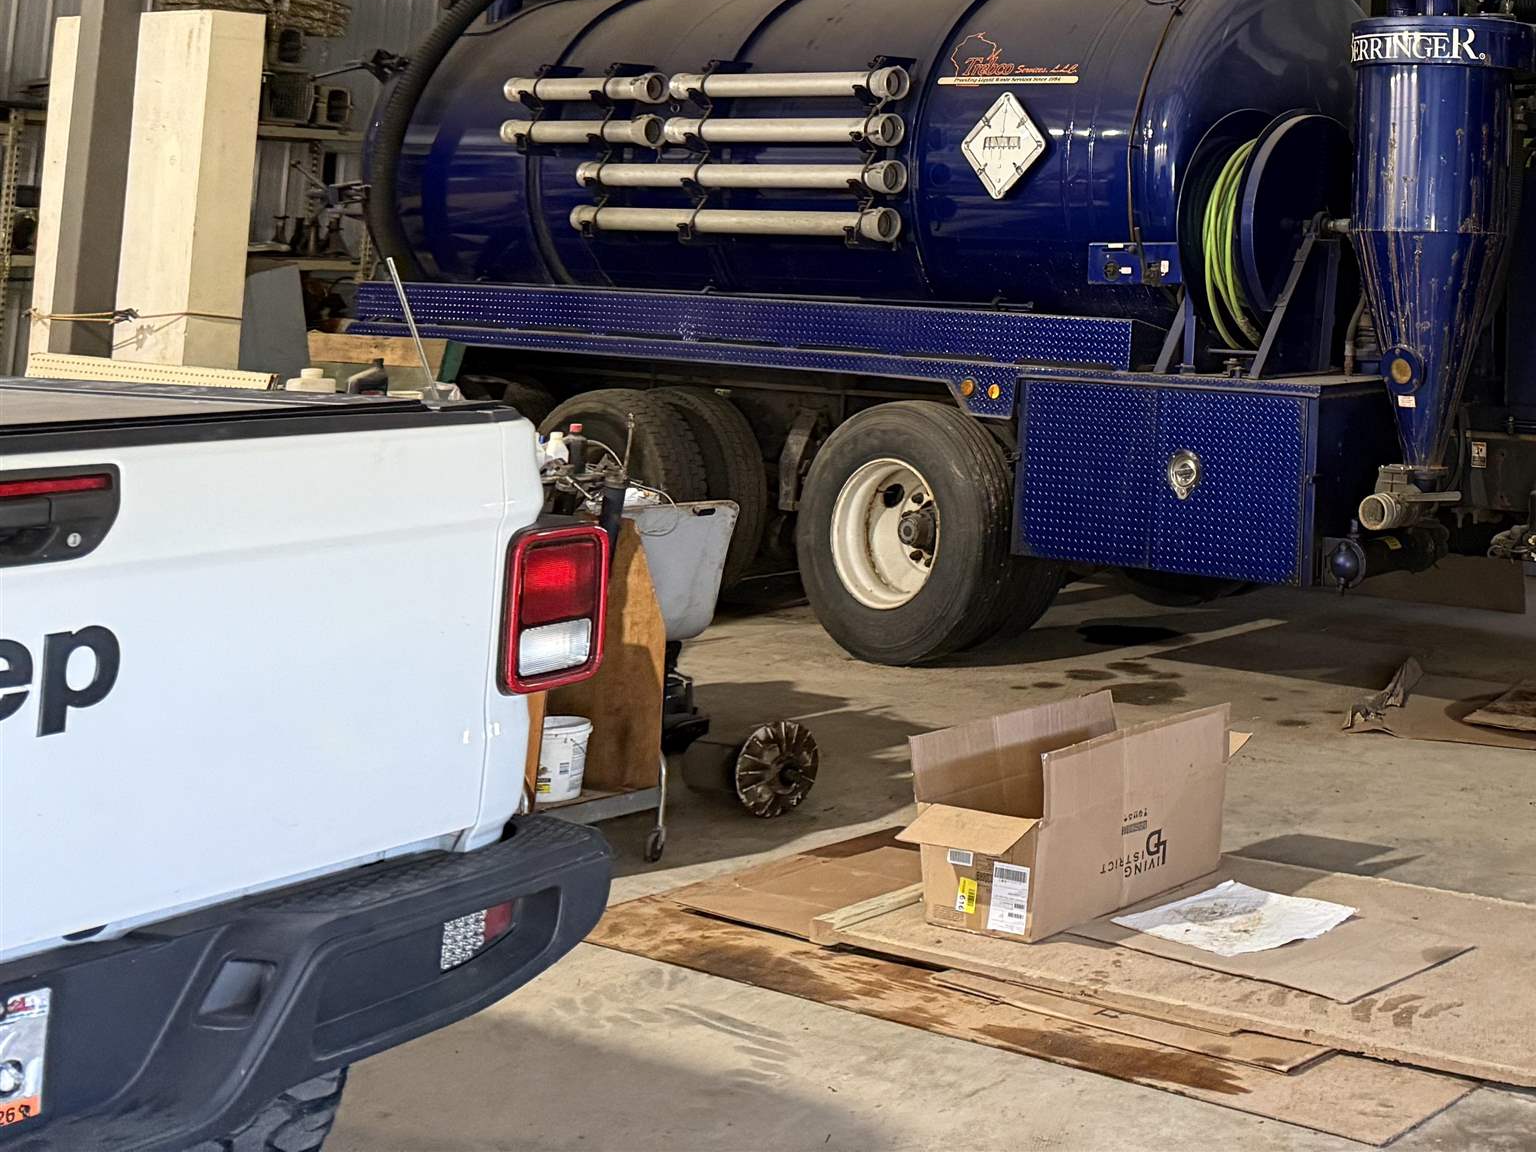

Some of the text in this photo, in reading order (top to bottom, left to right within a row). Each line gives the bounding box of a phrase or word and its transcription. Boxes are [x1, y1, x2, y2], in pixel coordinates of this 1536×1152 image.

[1350, 28, 1480, 63] ERRINGER
[1099, 828, 1163, 875] DISTRICT
[1123, 839, 1169, 879] LIVING
